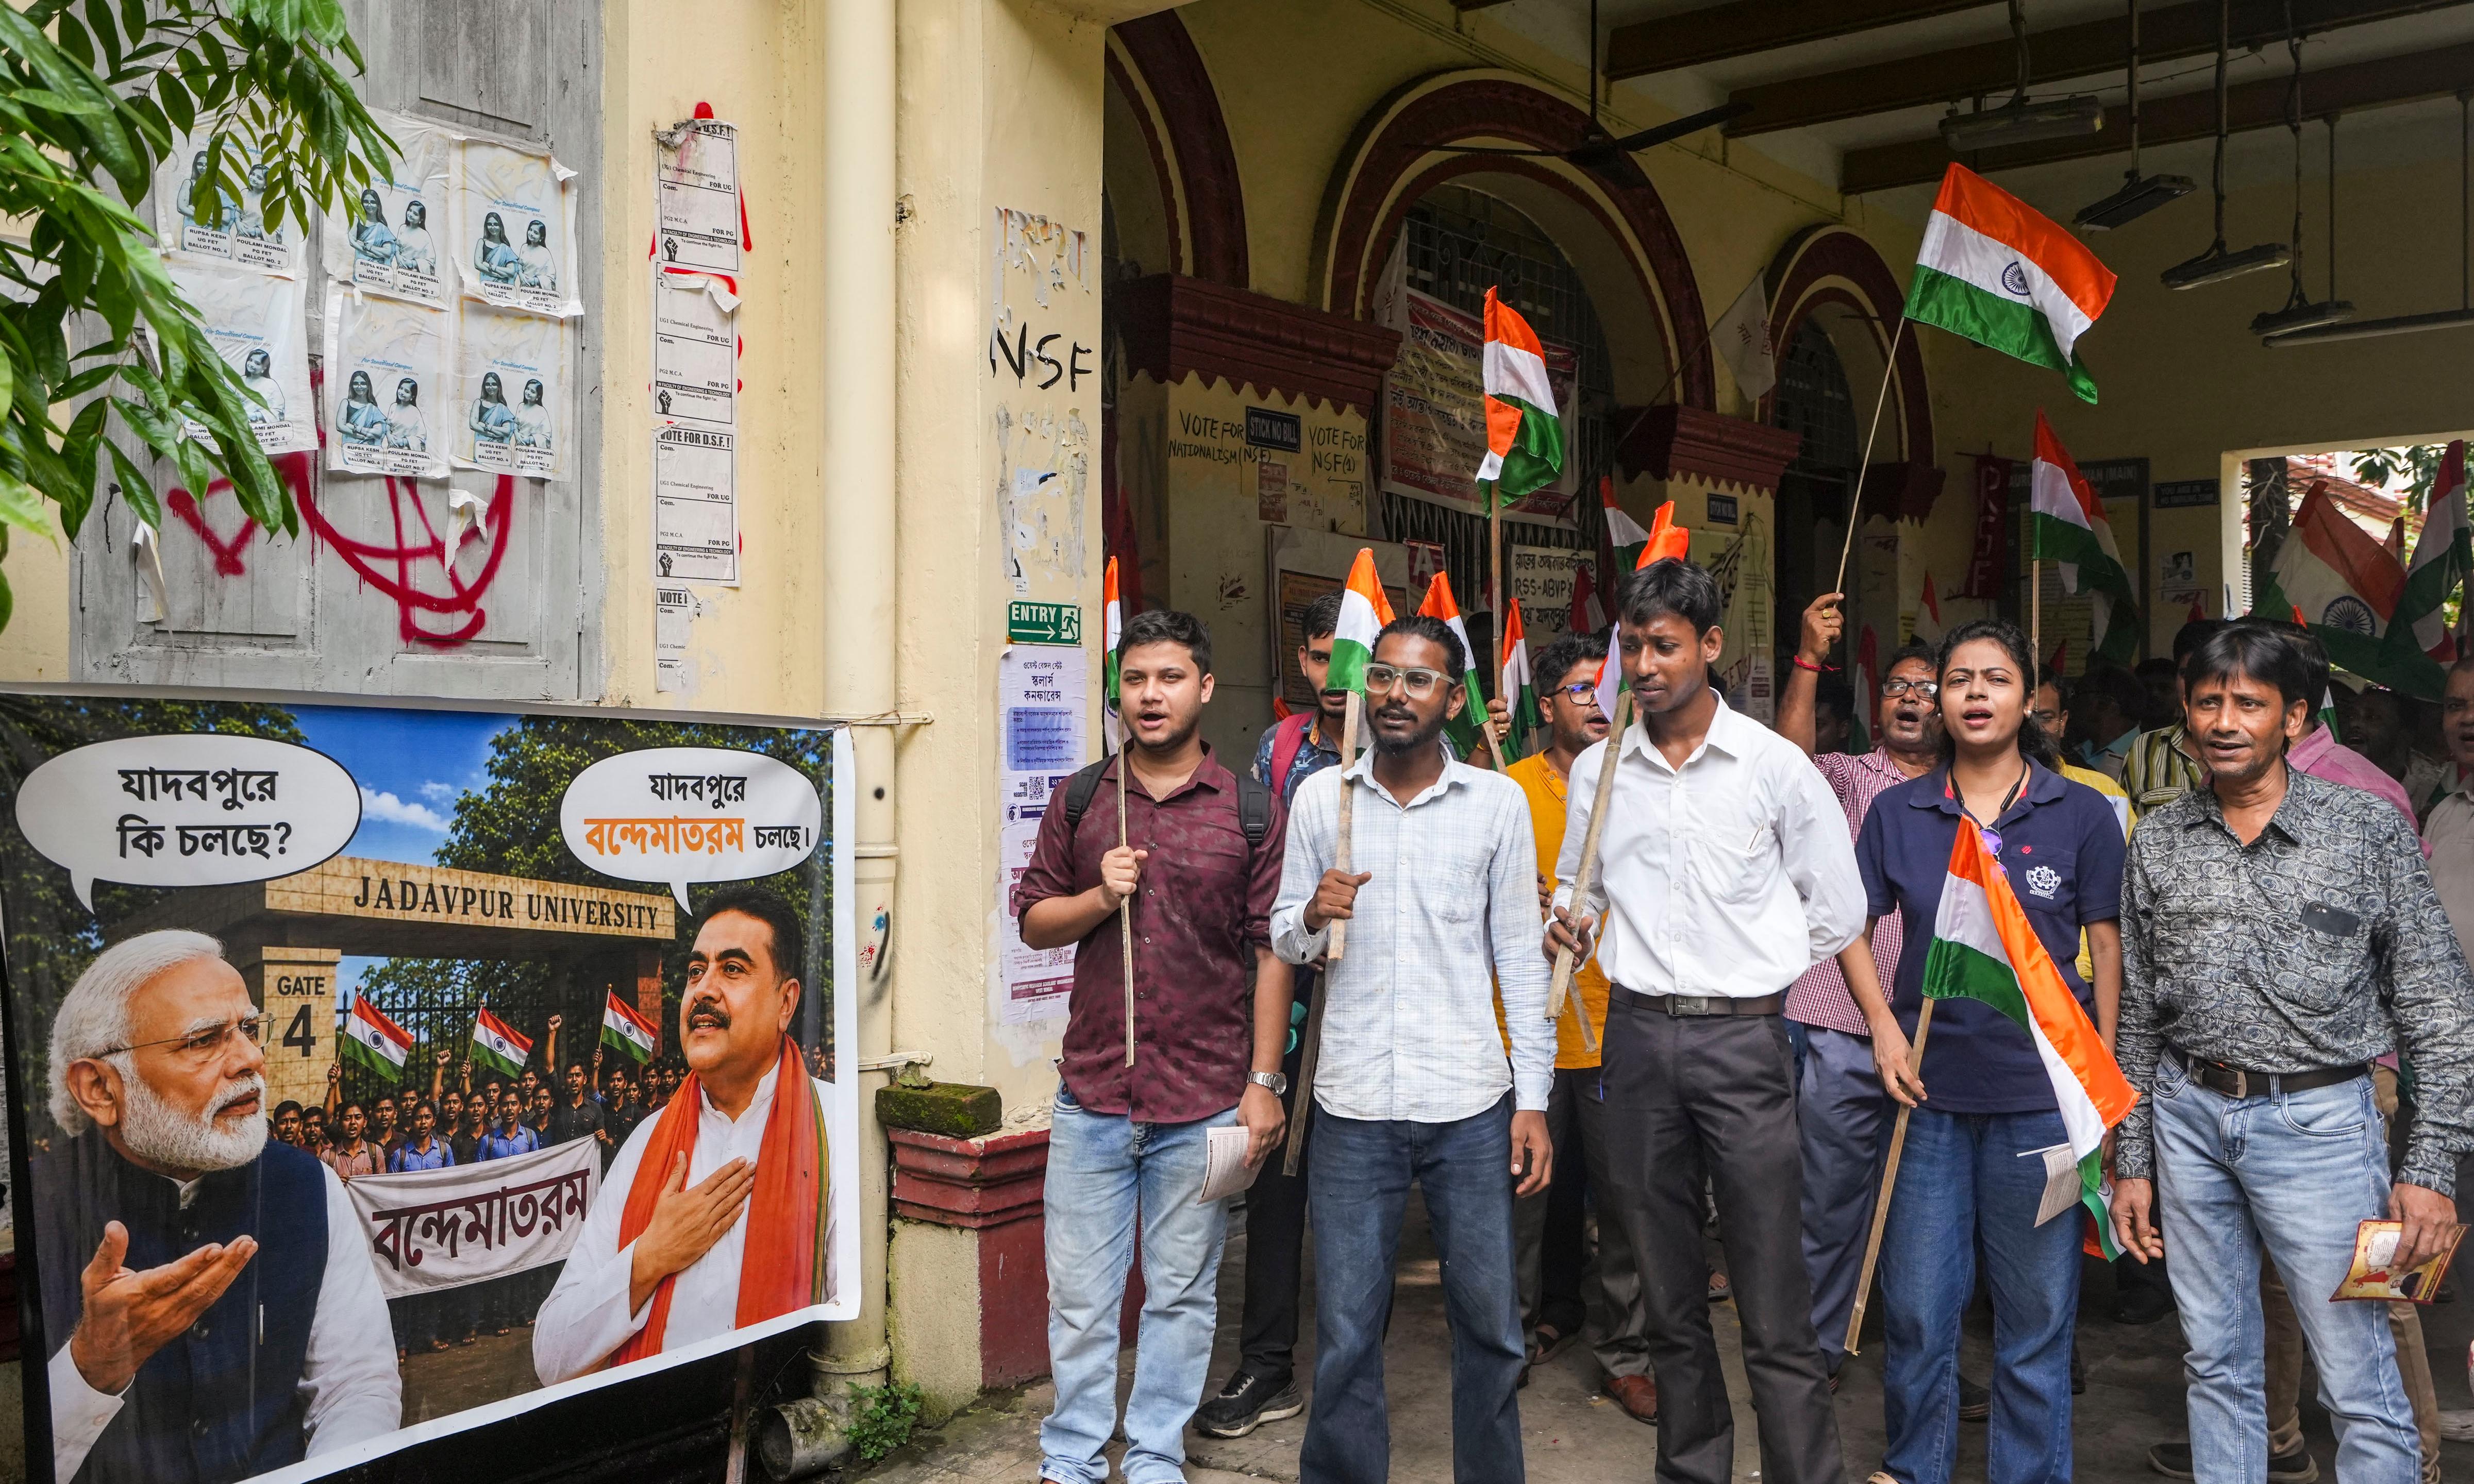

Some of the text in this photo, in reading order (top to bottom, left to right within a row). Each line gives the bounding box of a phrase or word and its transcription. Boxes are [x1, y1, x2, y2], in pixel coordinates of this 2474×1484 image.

[693, 170, 715, 179] Engineering
[190, 228, 209, 237] RUPSA
[237, 239, 288, 253] POULAMI MONDAL
[215, 329, 242, 338] Sensitised
[670, 319, 689, 328] Chemical
[691, 324, 713, 332] Engineering
[990, 322, 1092, 392] NSF
[1179, 409, 1244, 443] VOTE FOR
[1250, 416, 1297, 444] STICK NO BILL
[660, 430, 682, 442] VOTE
[684, 431, 701, 444] FOR
[703, 435, 725, 447] D.S.F.
[1309, 425, 1365, 451] VOTE FOR
[660, 592, 682, 603] VOTE
[1012, 604, 1057, 623] ENTRY
[1031, 672, 1054, 687] স্কলার্স
[1024, 690, 1061, 702] কনফারেন্স
[118, 767, 278, 810] যাদবপুরে
[649, 772, 746, 810] যাদবপুরে
[116, 814, 292, 859] কি চলছে?
[584, 816, 810, 855] বন্দেমাতরম চলছে।
[354, 876, 659, 930] JADAVPUR UNIVERSITY
[277, 976, 325, 997] GATE
[283, 1004, 316, 1058] 4
[372, 1168, 590, 1272] বন্দেমাতরম
